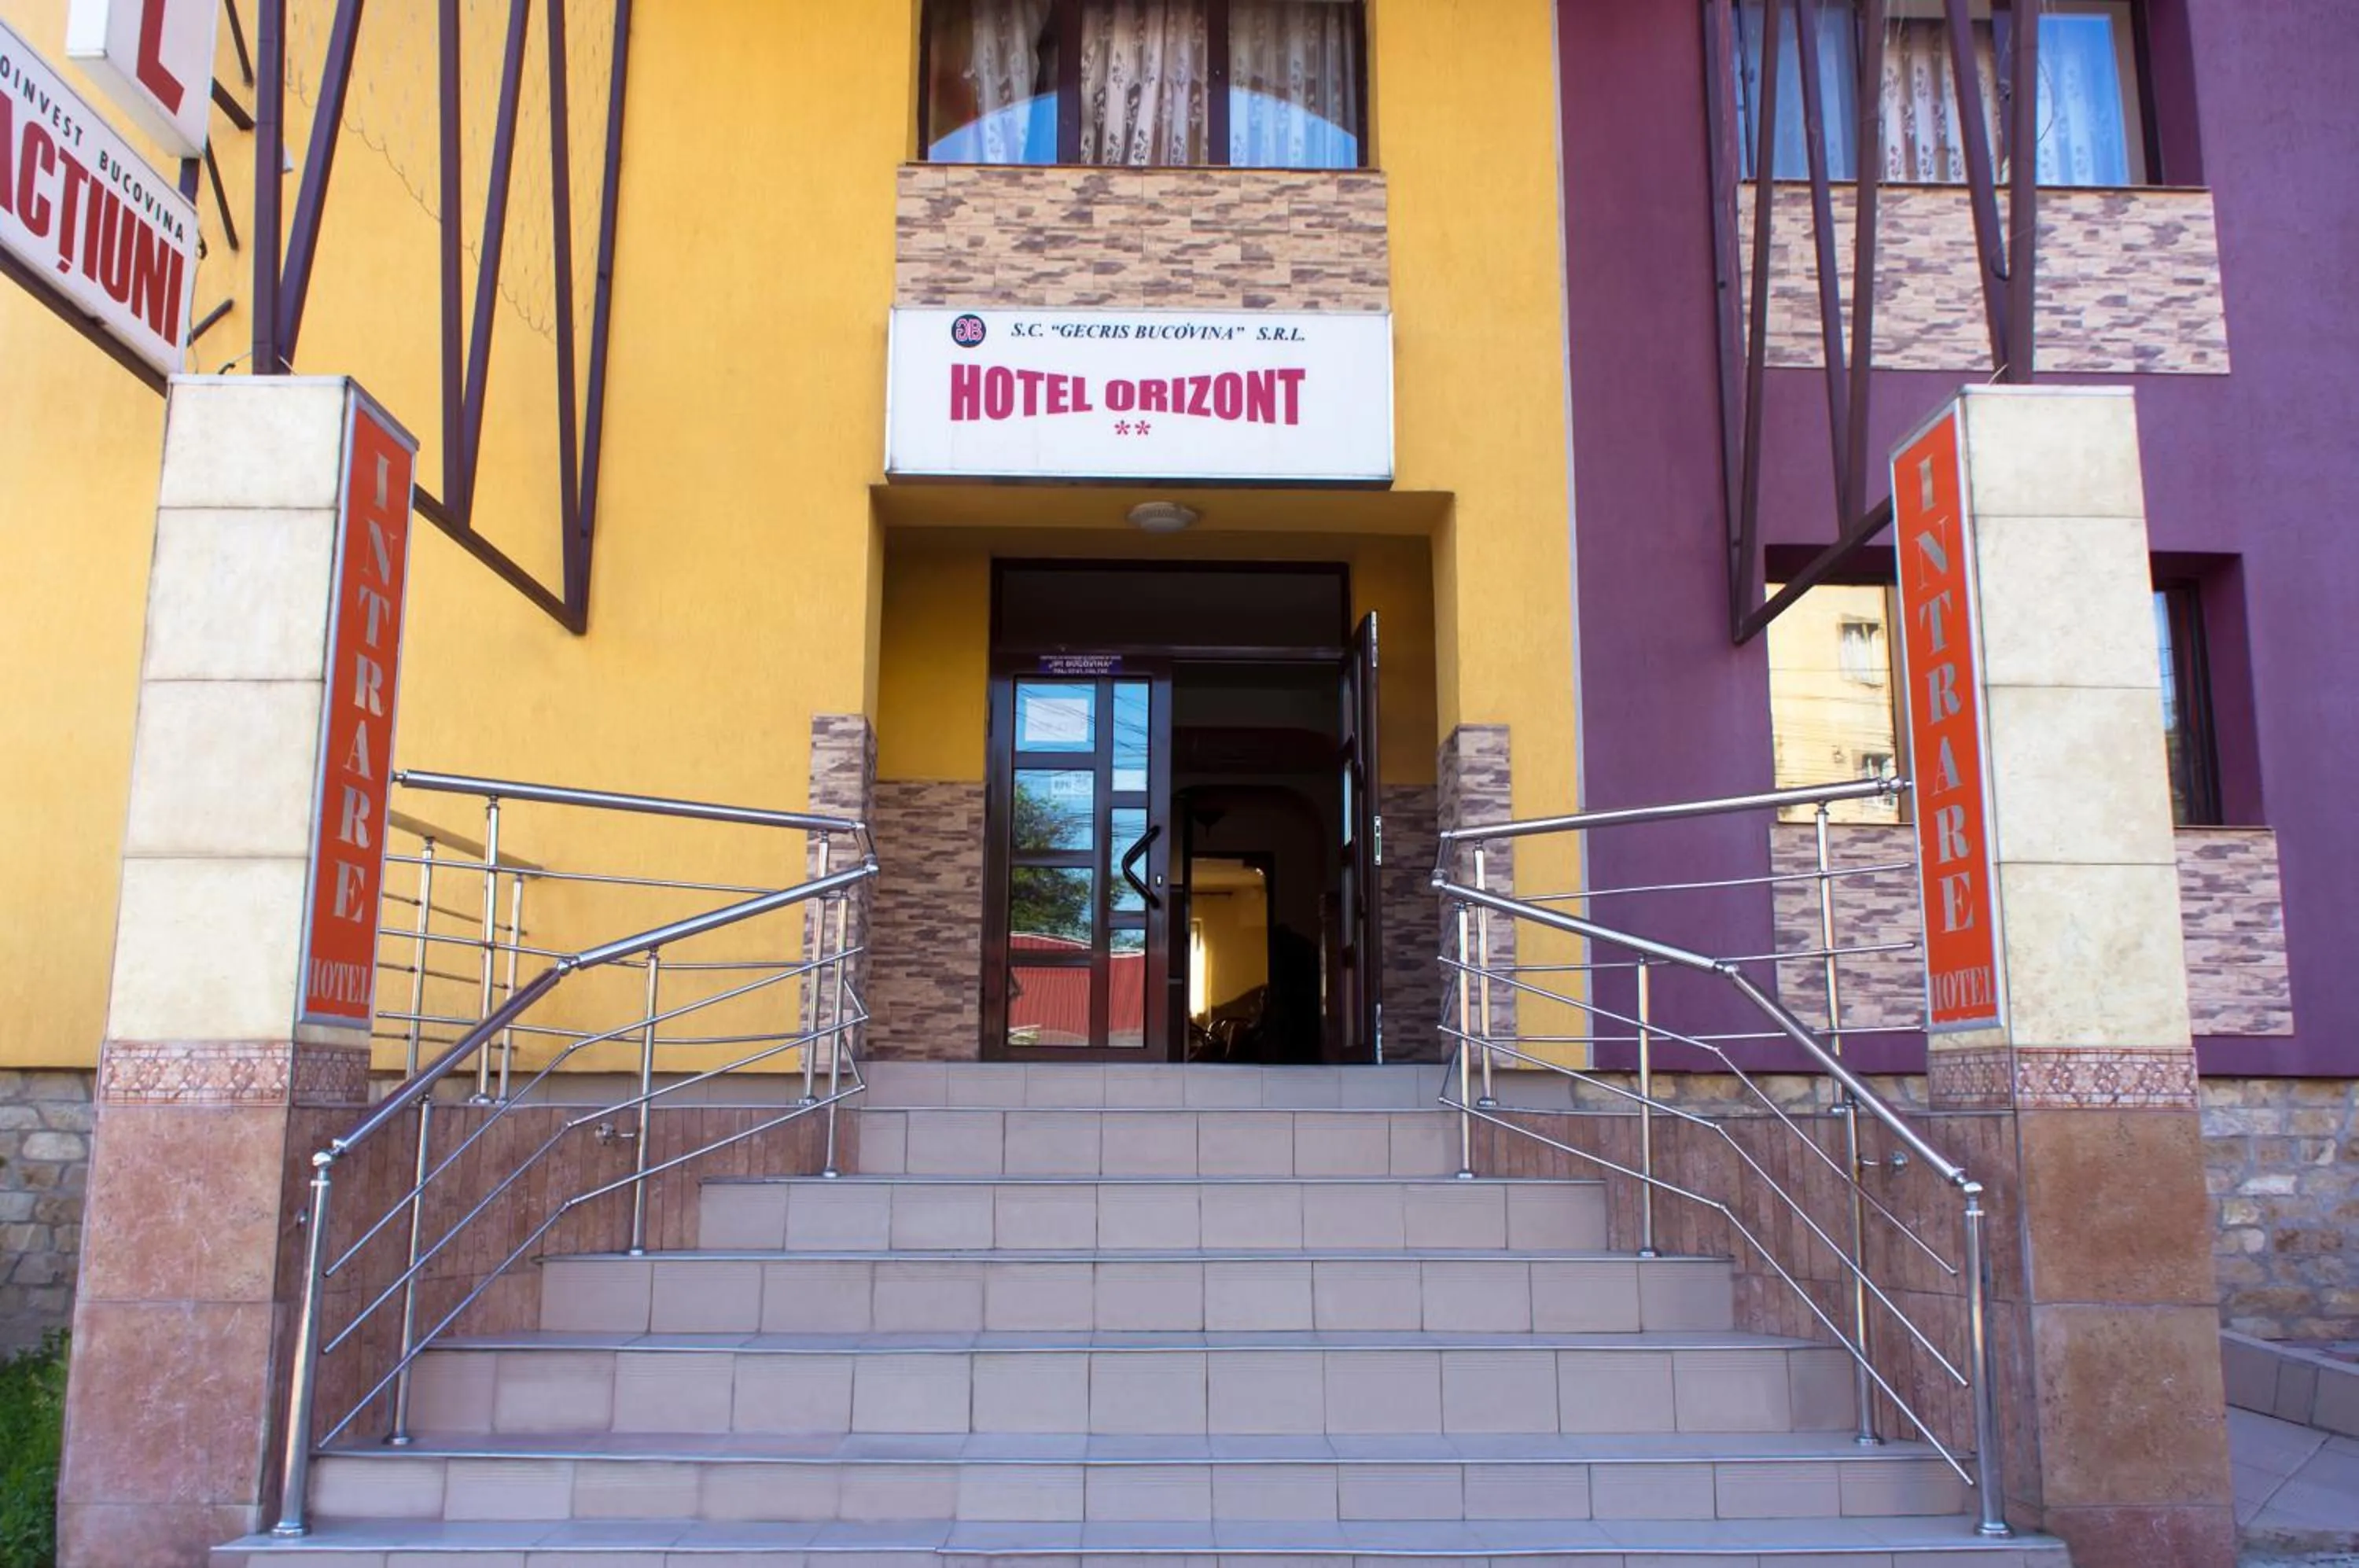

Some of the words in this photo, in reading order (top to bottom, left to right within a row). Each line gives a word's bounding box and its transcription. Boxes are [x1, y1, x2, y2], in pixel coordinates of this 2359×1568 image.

[99, 150, 184, 243] BUCOVINA
[1010, 322, 1043, 337] S.C.
[1256, 326, 1306, 341] S.R.L.
[950, 364, 1092, 422] HOTEL
[1105, 368, 1306, 425] ORIZONT
[333, 451, 396, 923] INTRARE
[1914, 454, 1973, 934] INTRARE
[307, 957, 371, 1005] HOTEL
[1930, 966, 1993, 1012] HOTEL
